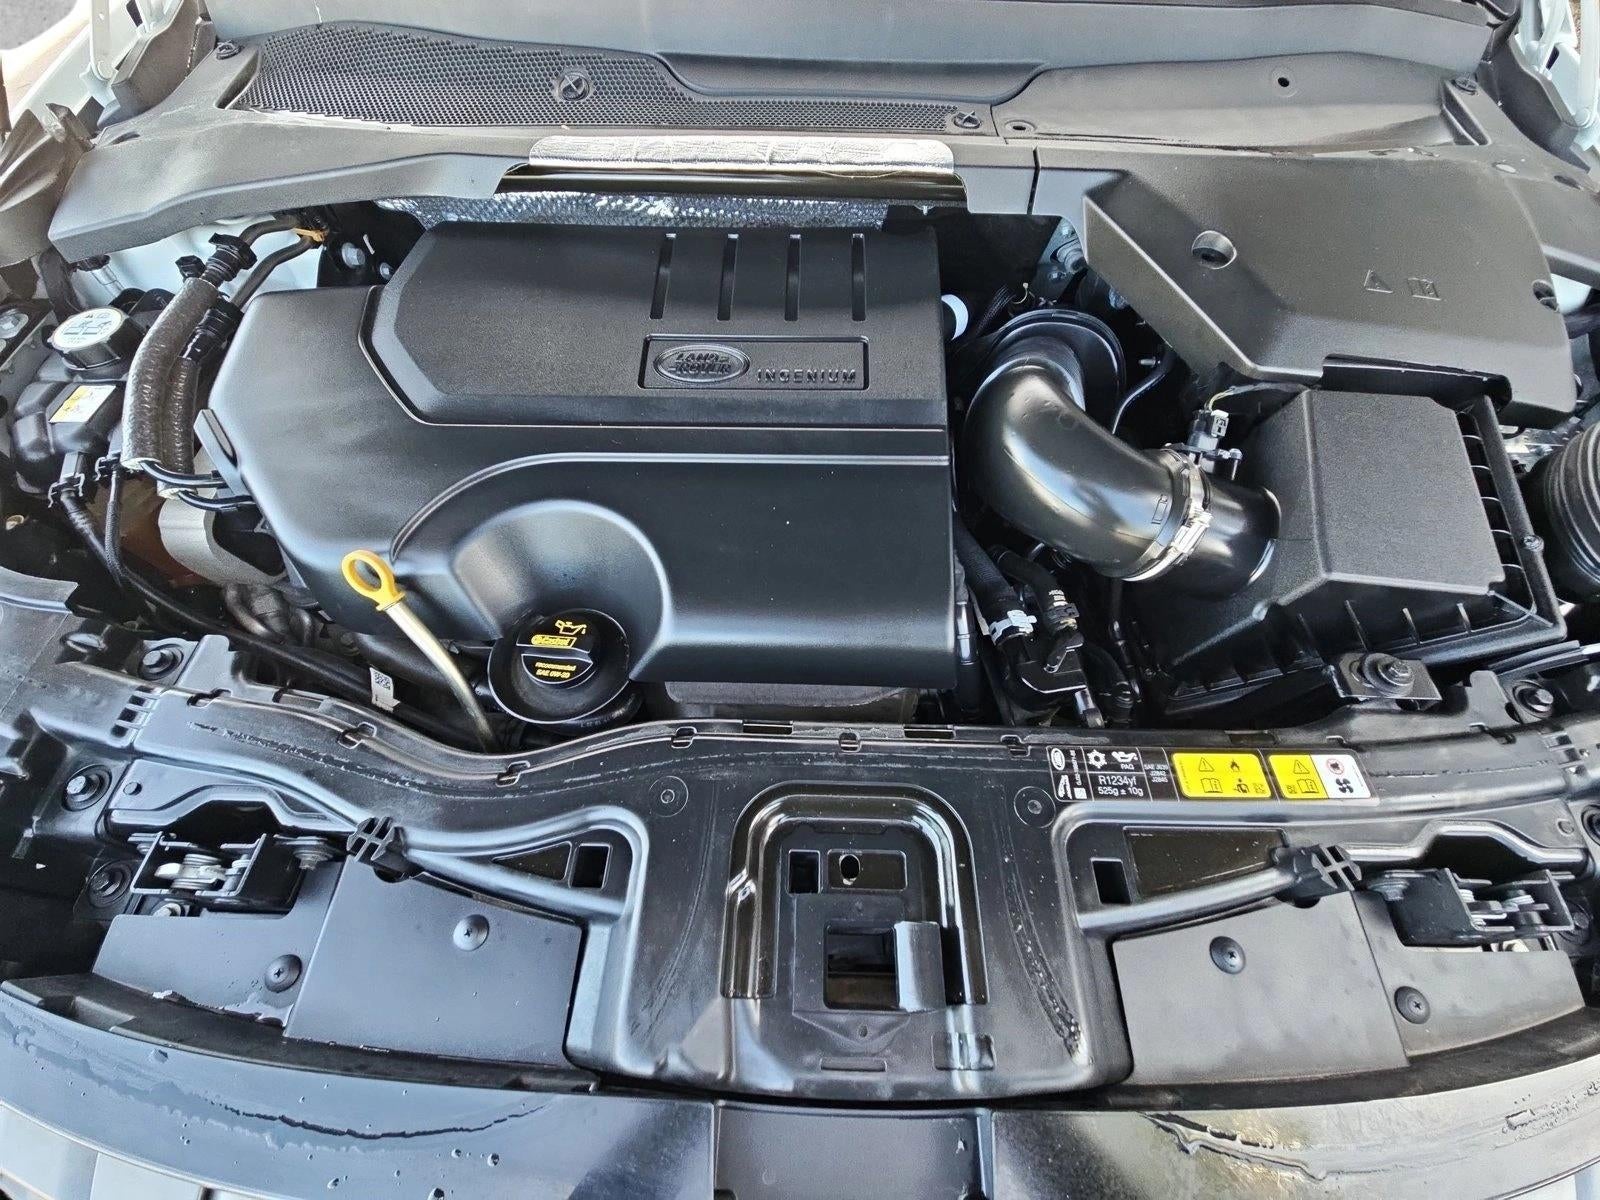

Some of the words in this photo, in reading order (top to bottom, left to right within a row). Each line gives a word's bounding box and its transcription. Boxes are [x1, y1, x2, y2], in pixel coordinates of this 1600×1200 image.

[675, 352, 720, 362] LAND
[675, 361, 731, 374] ROVER
[757, 368, 856, 384] INGENIUM
[536, 669, 550, 677] SAE
[1098, 775, 1137, 787] R1234yf
[1097, 787, 1119, 797] 525g
[1128, 787, 1144, 797] 10g
